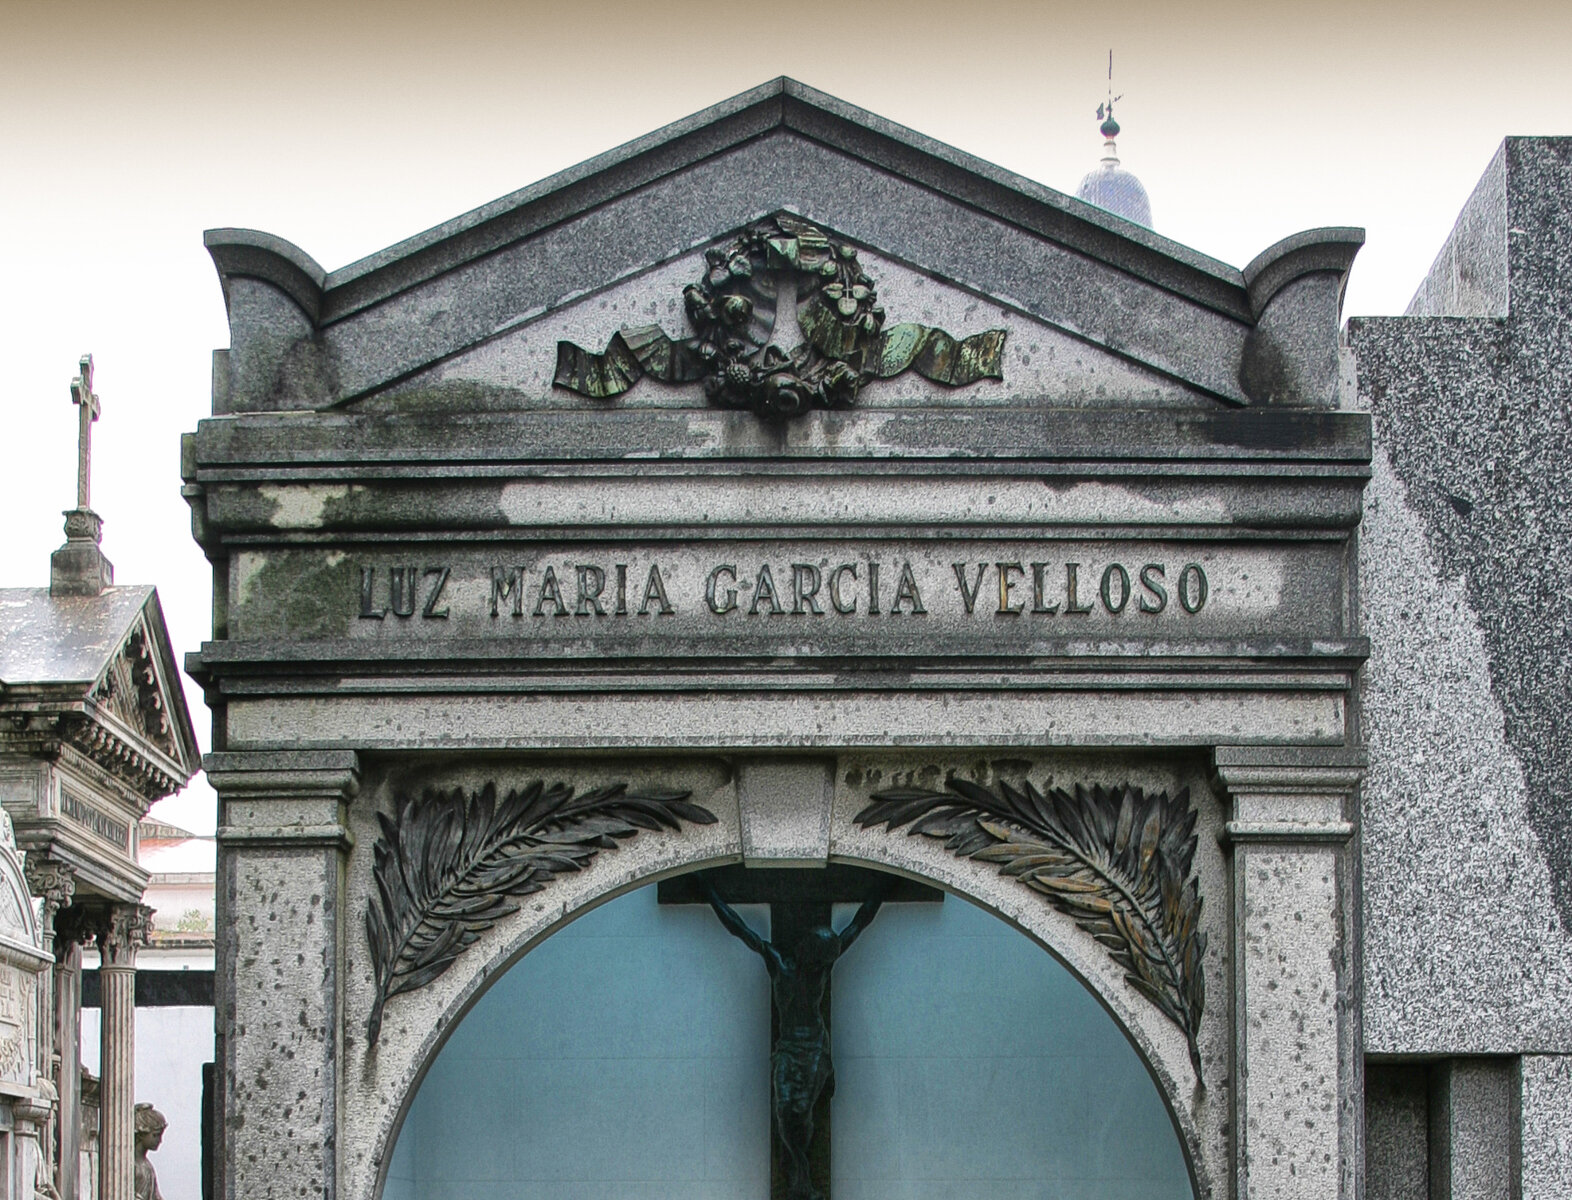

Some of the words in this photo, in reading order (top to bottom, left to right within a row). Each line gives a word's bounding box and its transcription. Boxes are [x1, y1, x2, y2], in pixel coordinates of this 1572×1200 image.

[358, 566, 451, 620] LUZ
[490, 564, 676, 616] MARIA
[705, 563, 928, 616] GARCIA
[951, 562, 1209, 614] VELLOSO
